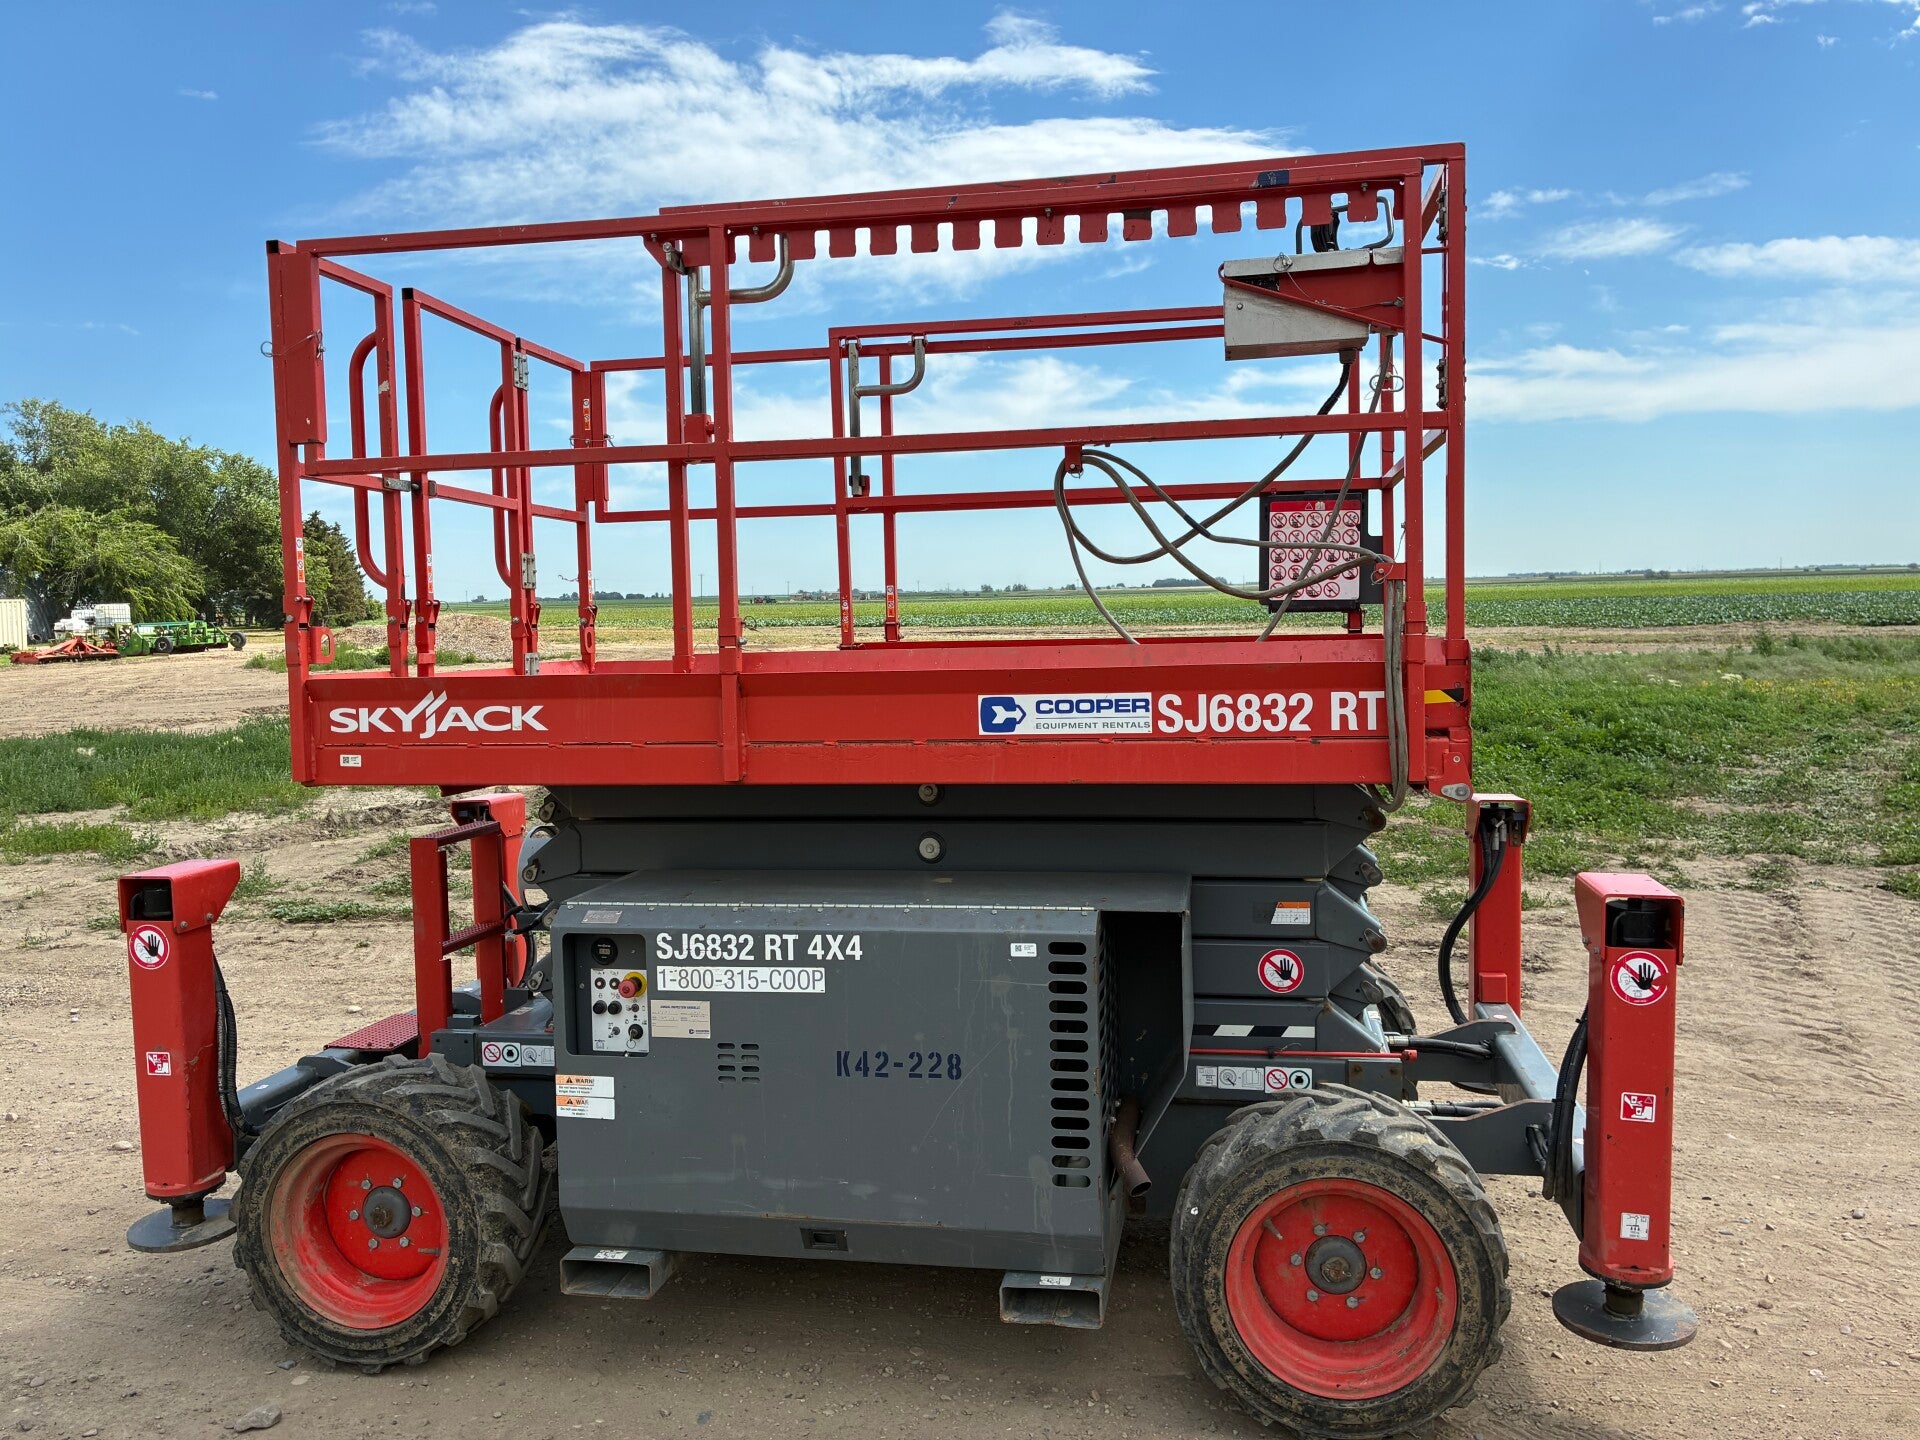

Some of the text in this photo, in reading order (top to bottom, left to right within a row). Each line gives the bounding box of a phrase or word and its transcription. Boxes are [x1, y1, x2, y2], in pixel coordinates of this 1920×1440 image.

[329, 690, 549, 739] SKYJACK
[1035, 699, 1150, 714] COOPER
[1157, 691, 1385, 733] SJ6832 RT
[1035, 721, 1151, 730] EQUIPMENT RENTALS
[656, 932, 863, 961] SJ6832 RT 4X4
[658, 968, 824, 990] 1-800-315-COOP
[836, 1050, 962, 1080] K42-228
